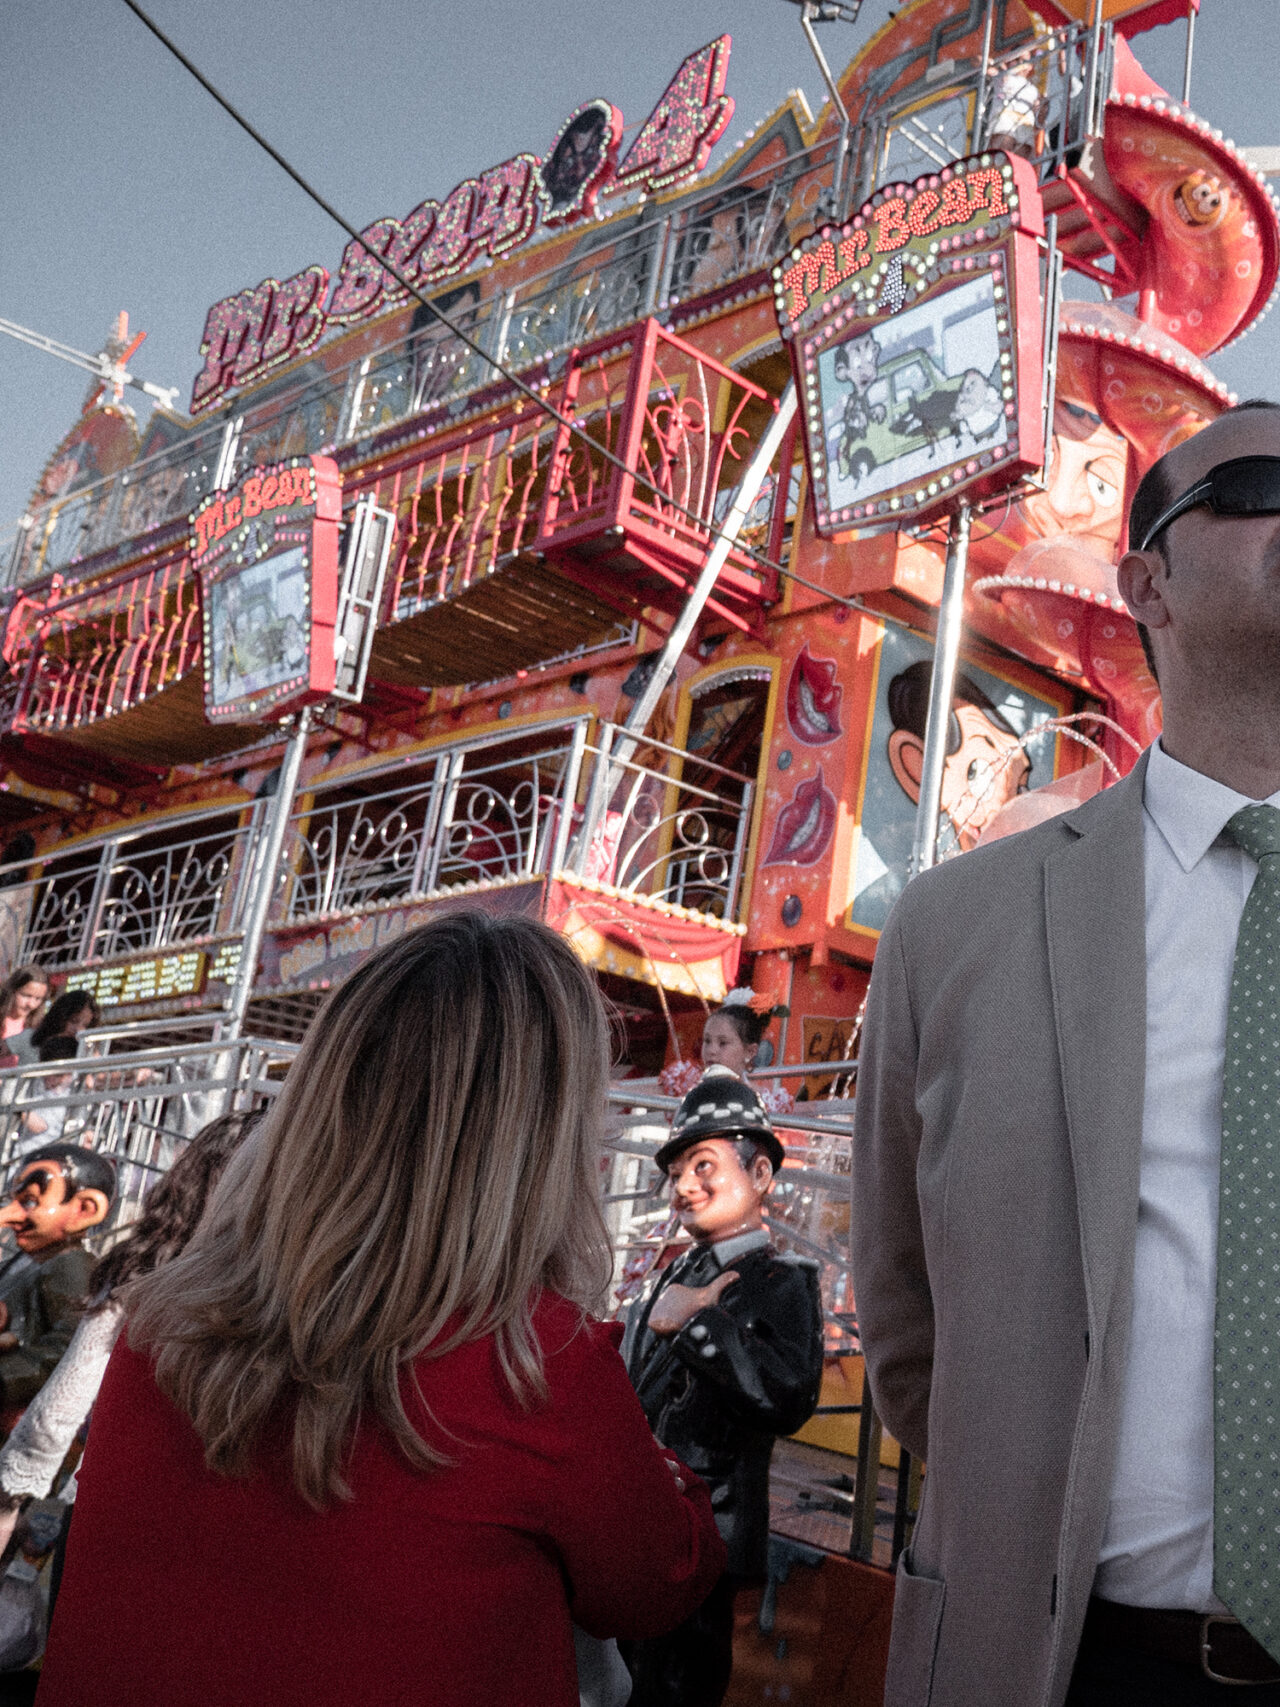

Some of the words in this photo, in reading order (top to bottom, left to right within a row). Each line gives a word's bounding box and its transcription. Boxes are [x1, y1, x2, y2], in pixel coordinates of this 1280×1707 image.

[326, 153, 543, 322] Bean
[605, 35, 735, 198] 4
[873, 168, 1008, 252] Bean
[878, 254, 908, 314] 4
[243, 468, 314, 517] Bean
